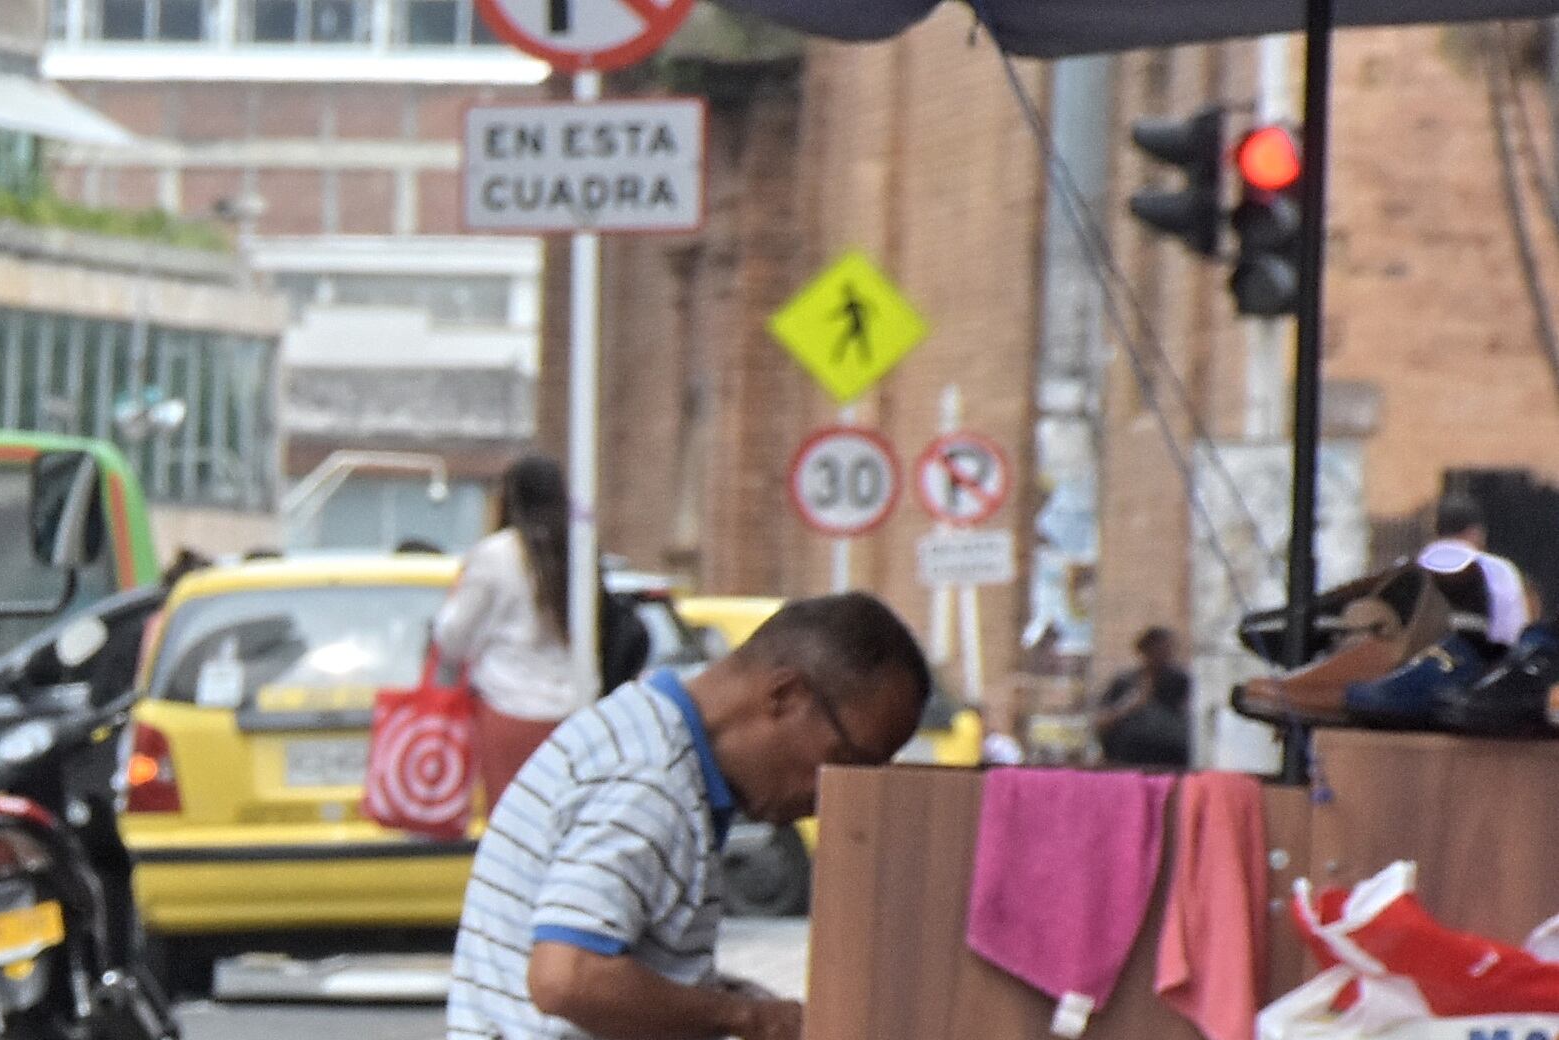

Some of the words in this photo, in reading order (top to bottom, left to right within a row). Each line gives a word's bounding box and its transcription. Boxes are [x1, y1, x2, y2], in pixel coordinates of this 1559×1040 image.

[483, 120, 544, 159] EN
[561, 120, 678, 159] ESTA
[482, 173, 678, 212] CUADRA
[808, 454, 885, 509] 30
